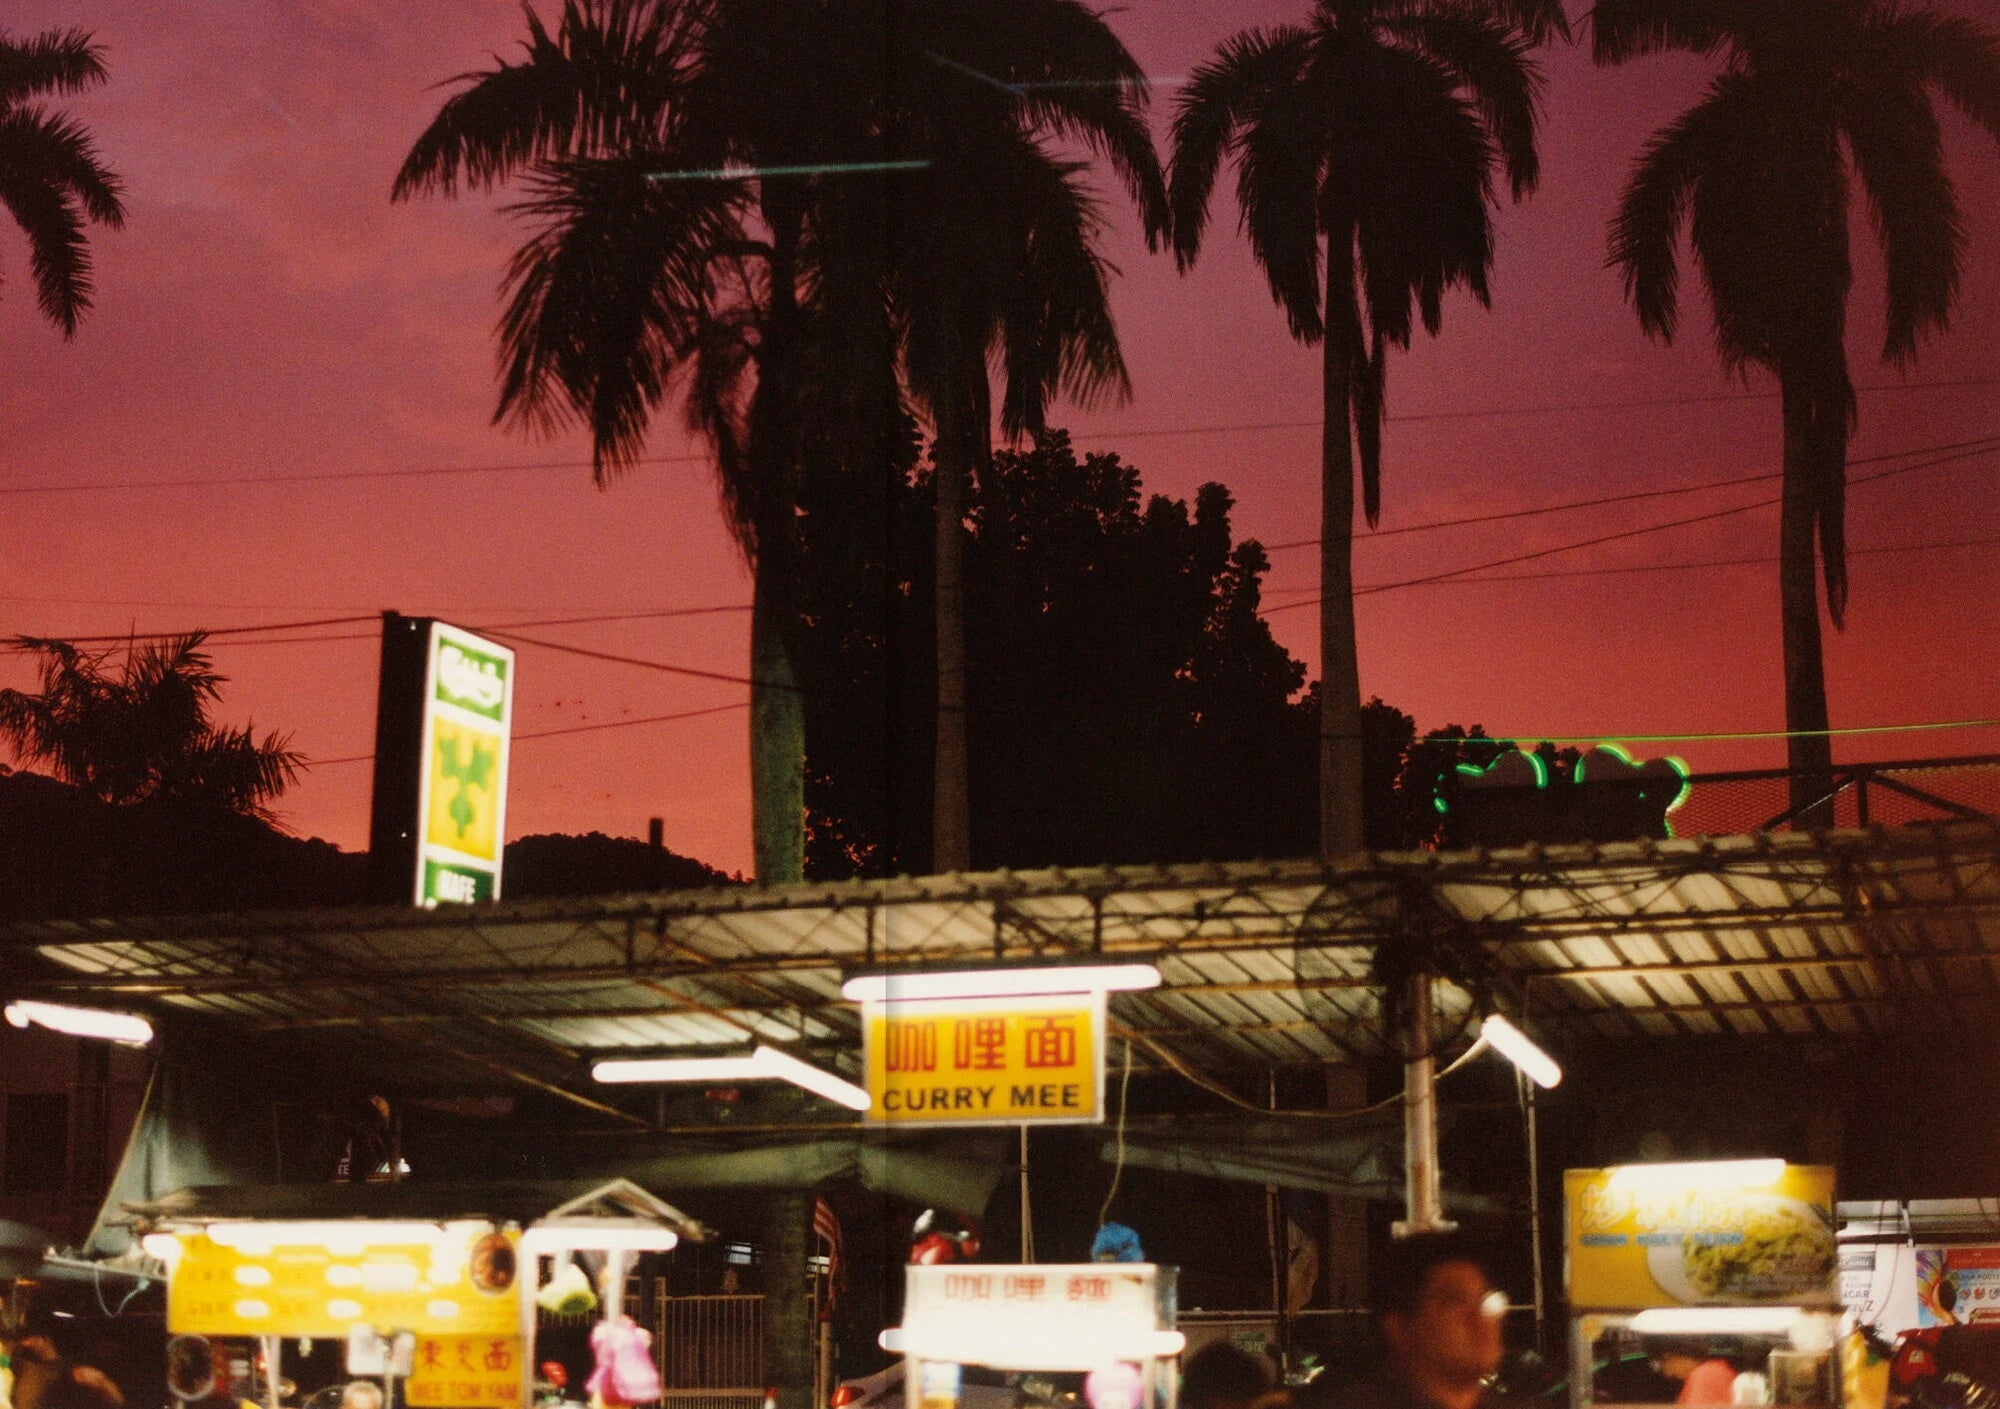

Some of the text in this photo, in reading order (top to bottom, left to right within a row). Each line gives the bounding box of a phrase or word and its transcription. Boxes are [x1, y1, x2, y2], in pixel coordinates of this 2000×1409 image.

[885, 1014, 1077, 1072] 咖哩面
[883, 1084, 1081, 1112] CURRY MEE
